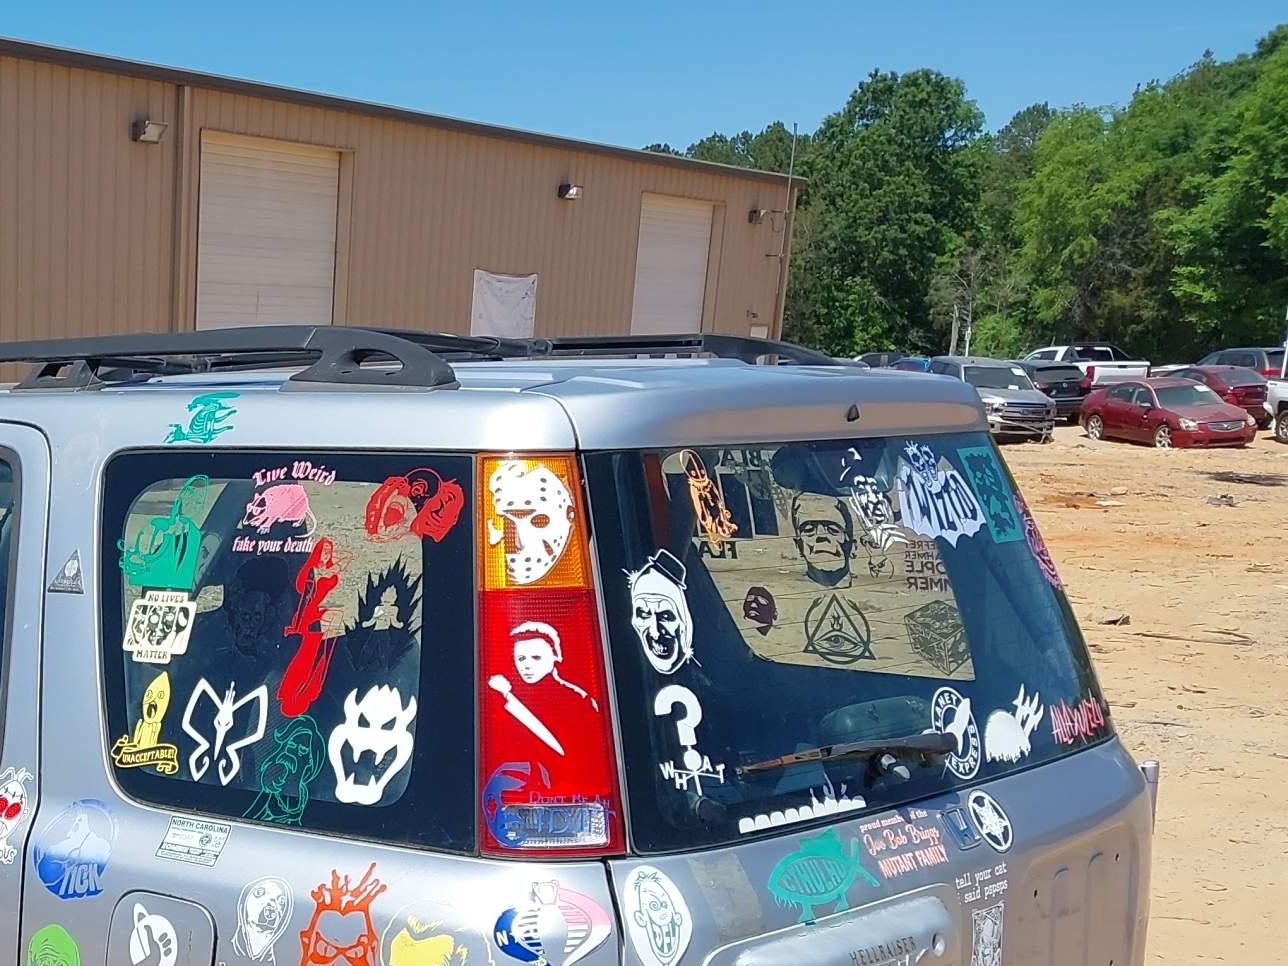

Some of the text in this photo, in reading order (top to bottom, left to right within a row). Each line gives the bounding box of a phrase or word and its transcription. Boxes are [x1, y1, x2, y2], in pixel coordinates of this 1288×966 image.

[291, 461, 336, 486] Weird
[257, 540, 283, 555] your
[284, 537, 313, 553] death
[147, 593, 185, 603] NO LIVES
[135, 650, 168, 660] MATTER
[934, 692, 958, 728] LANET
[121, 748, 175, 763] UNACCEPTABLE!
[172, 819, 228, 834] NORTH CAROLINA
[859, 818, 881, 834] proud
[883, 829, 908, 850] Bob
[905, 824, 940, 846] Briggs
[878, 844, 950, 879] MUTANT FAMILY
[955, 861, 1008, 889] tell your cat
[964, 886, 982, 903] said
[984, 880, 1008, 900] pspsps
